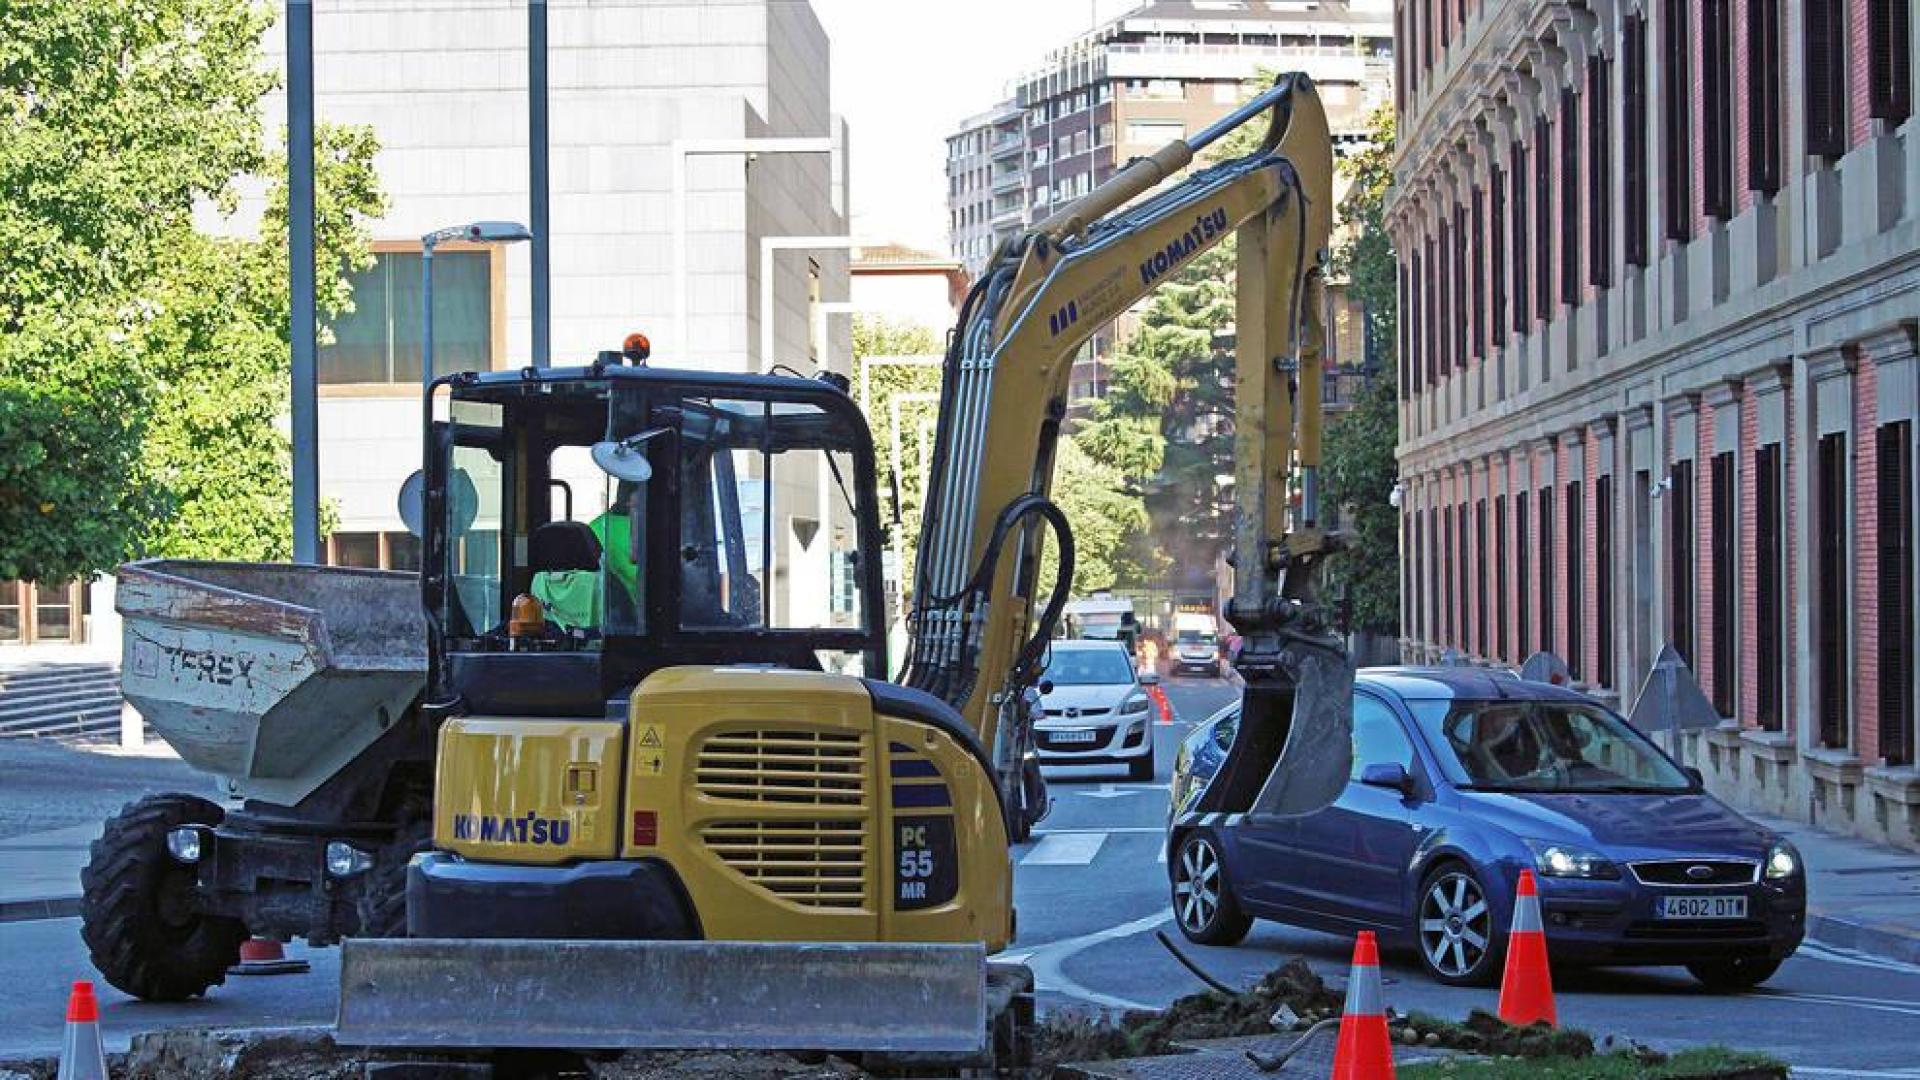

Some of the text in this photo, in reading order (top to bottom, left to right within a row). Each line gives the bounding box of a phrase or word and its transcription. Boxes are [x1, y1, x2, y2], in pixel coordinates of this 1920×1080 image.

[1140, 206, 1226, 284] KOMATSU
[455, 810, 570, 845] KOMATSU
[901, 826, 926, 847] PC
[901, 850, 933, 877] 55
[901, 881, 926, 899] MR
[1667, 899, 1710, 916] 4602
